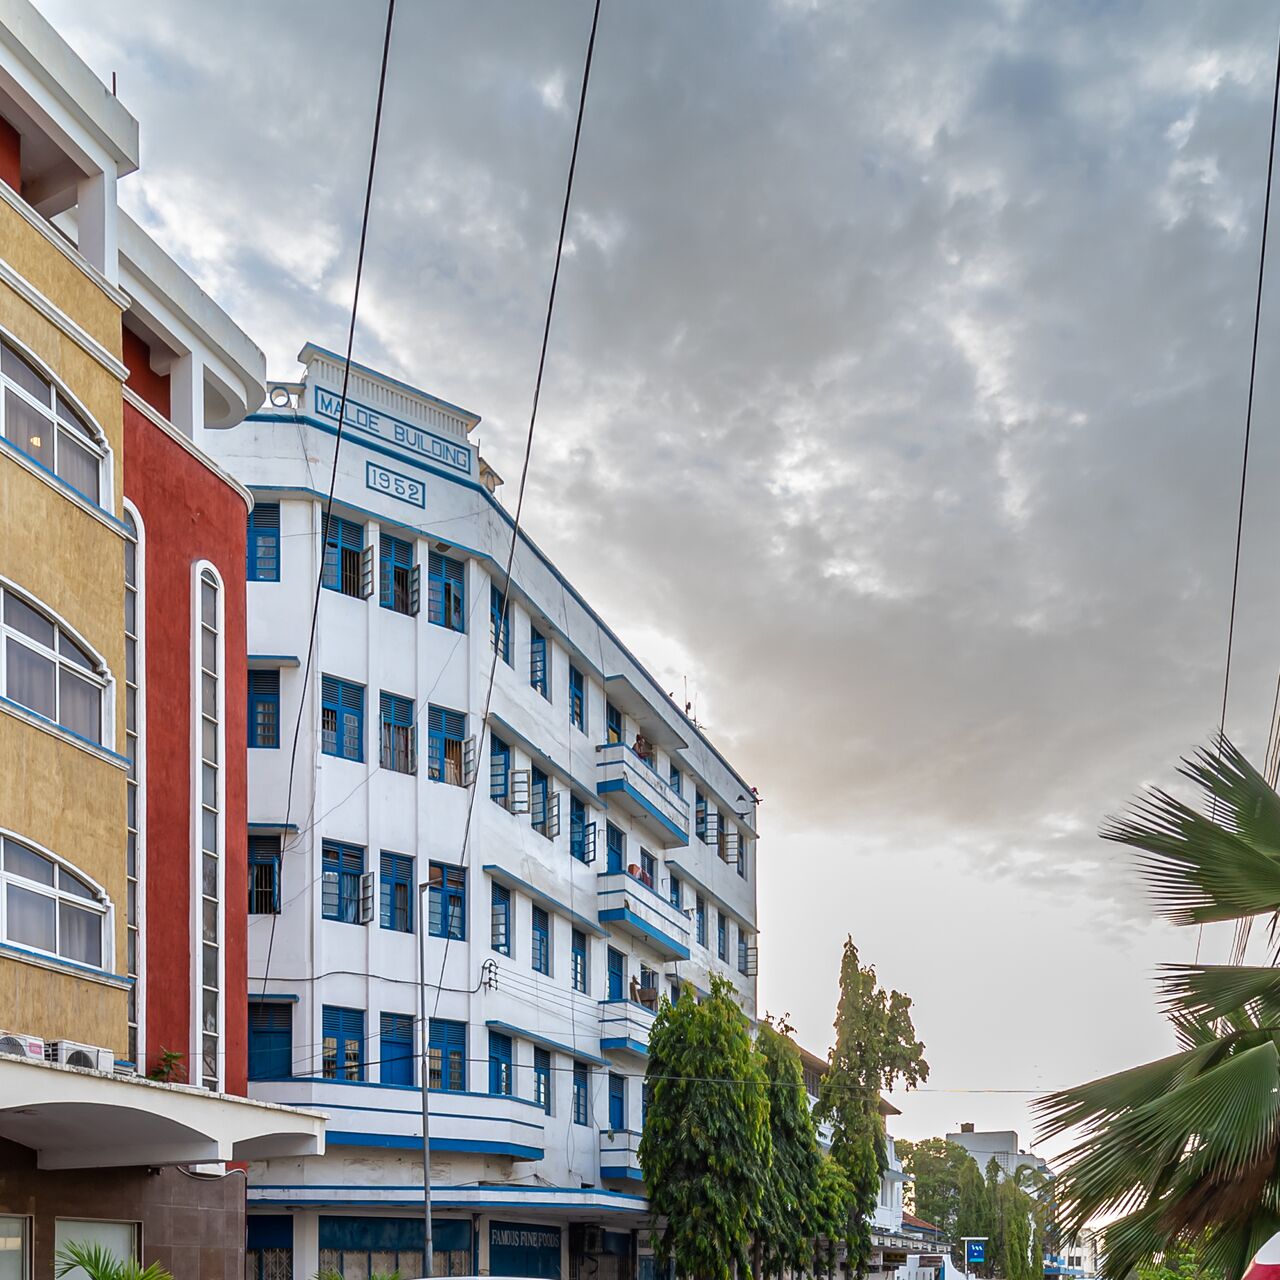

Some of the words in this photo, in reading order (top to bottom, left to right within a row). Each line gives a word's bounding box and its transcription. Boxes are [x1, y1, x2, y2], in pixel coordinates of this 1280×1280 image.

[394, 424, 467, 467] BUILDING
[371, 469, 420, 501] 1952
[491, 1229, 520, 1247] FAMOUS
